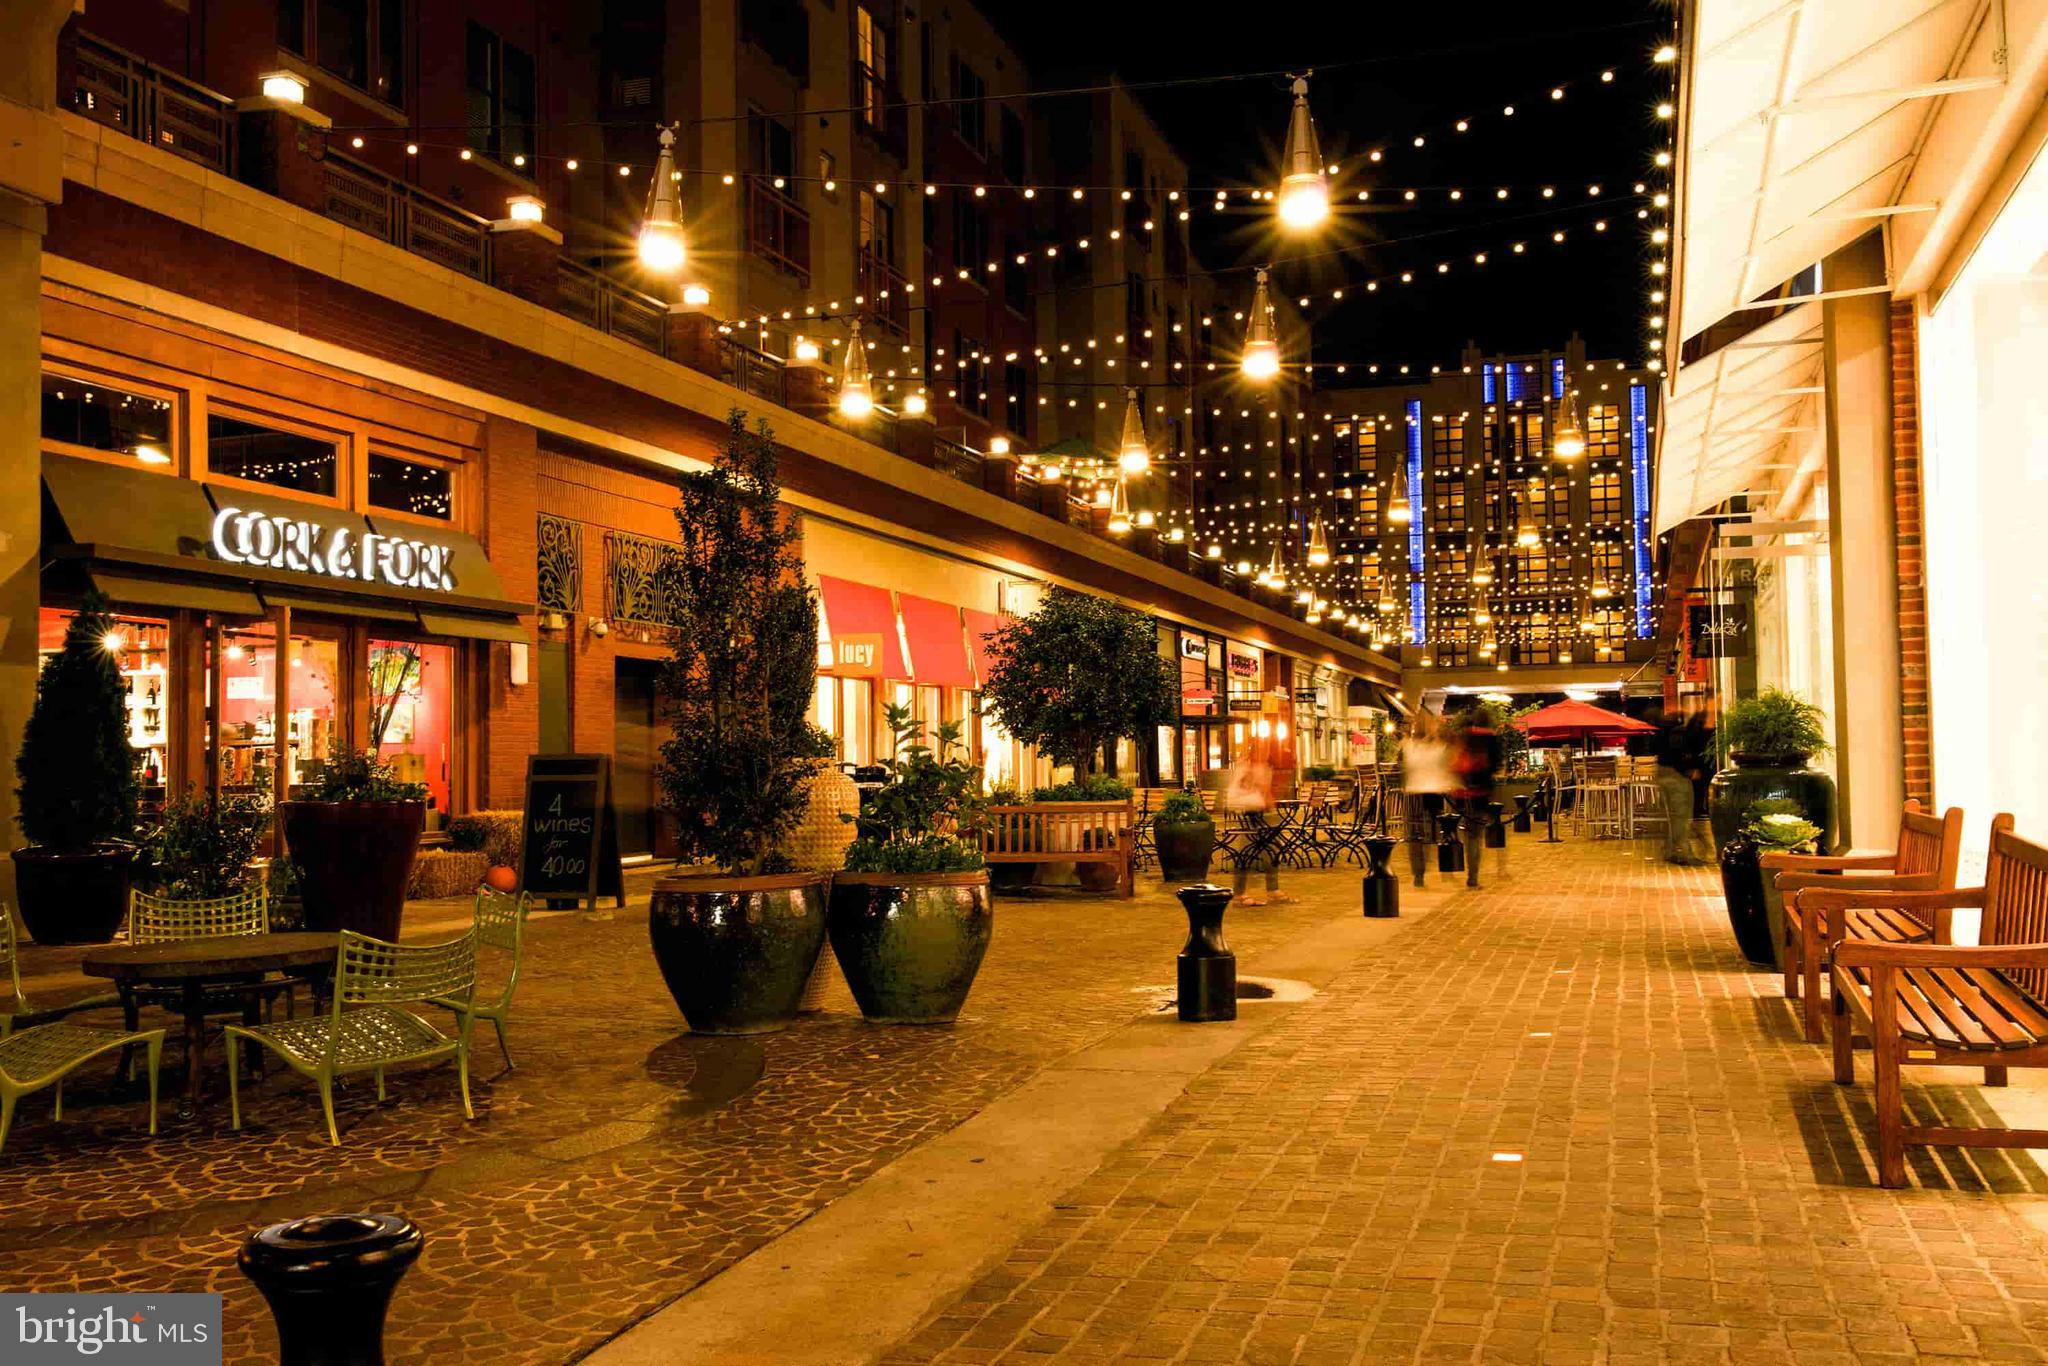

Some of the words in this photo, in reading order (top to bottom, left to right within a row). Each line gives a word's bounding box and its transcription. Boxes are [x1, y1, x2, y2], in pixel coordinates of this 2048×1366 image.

[213, 507, 326, 574] CORK
[328, 528, 357, 579] &
[363, 533, 459, 592] FORK
[839, 639, 874, 668] lucy
[548, 793, 562, 817] 4
[534, 817, 593, 834] wines
[544, 836, 569, 855] for
